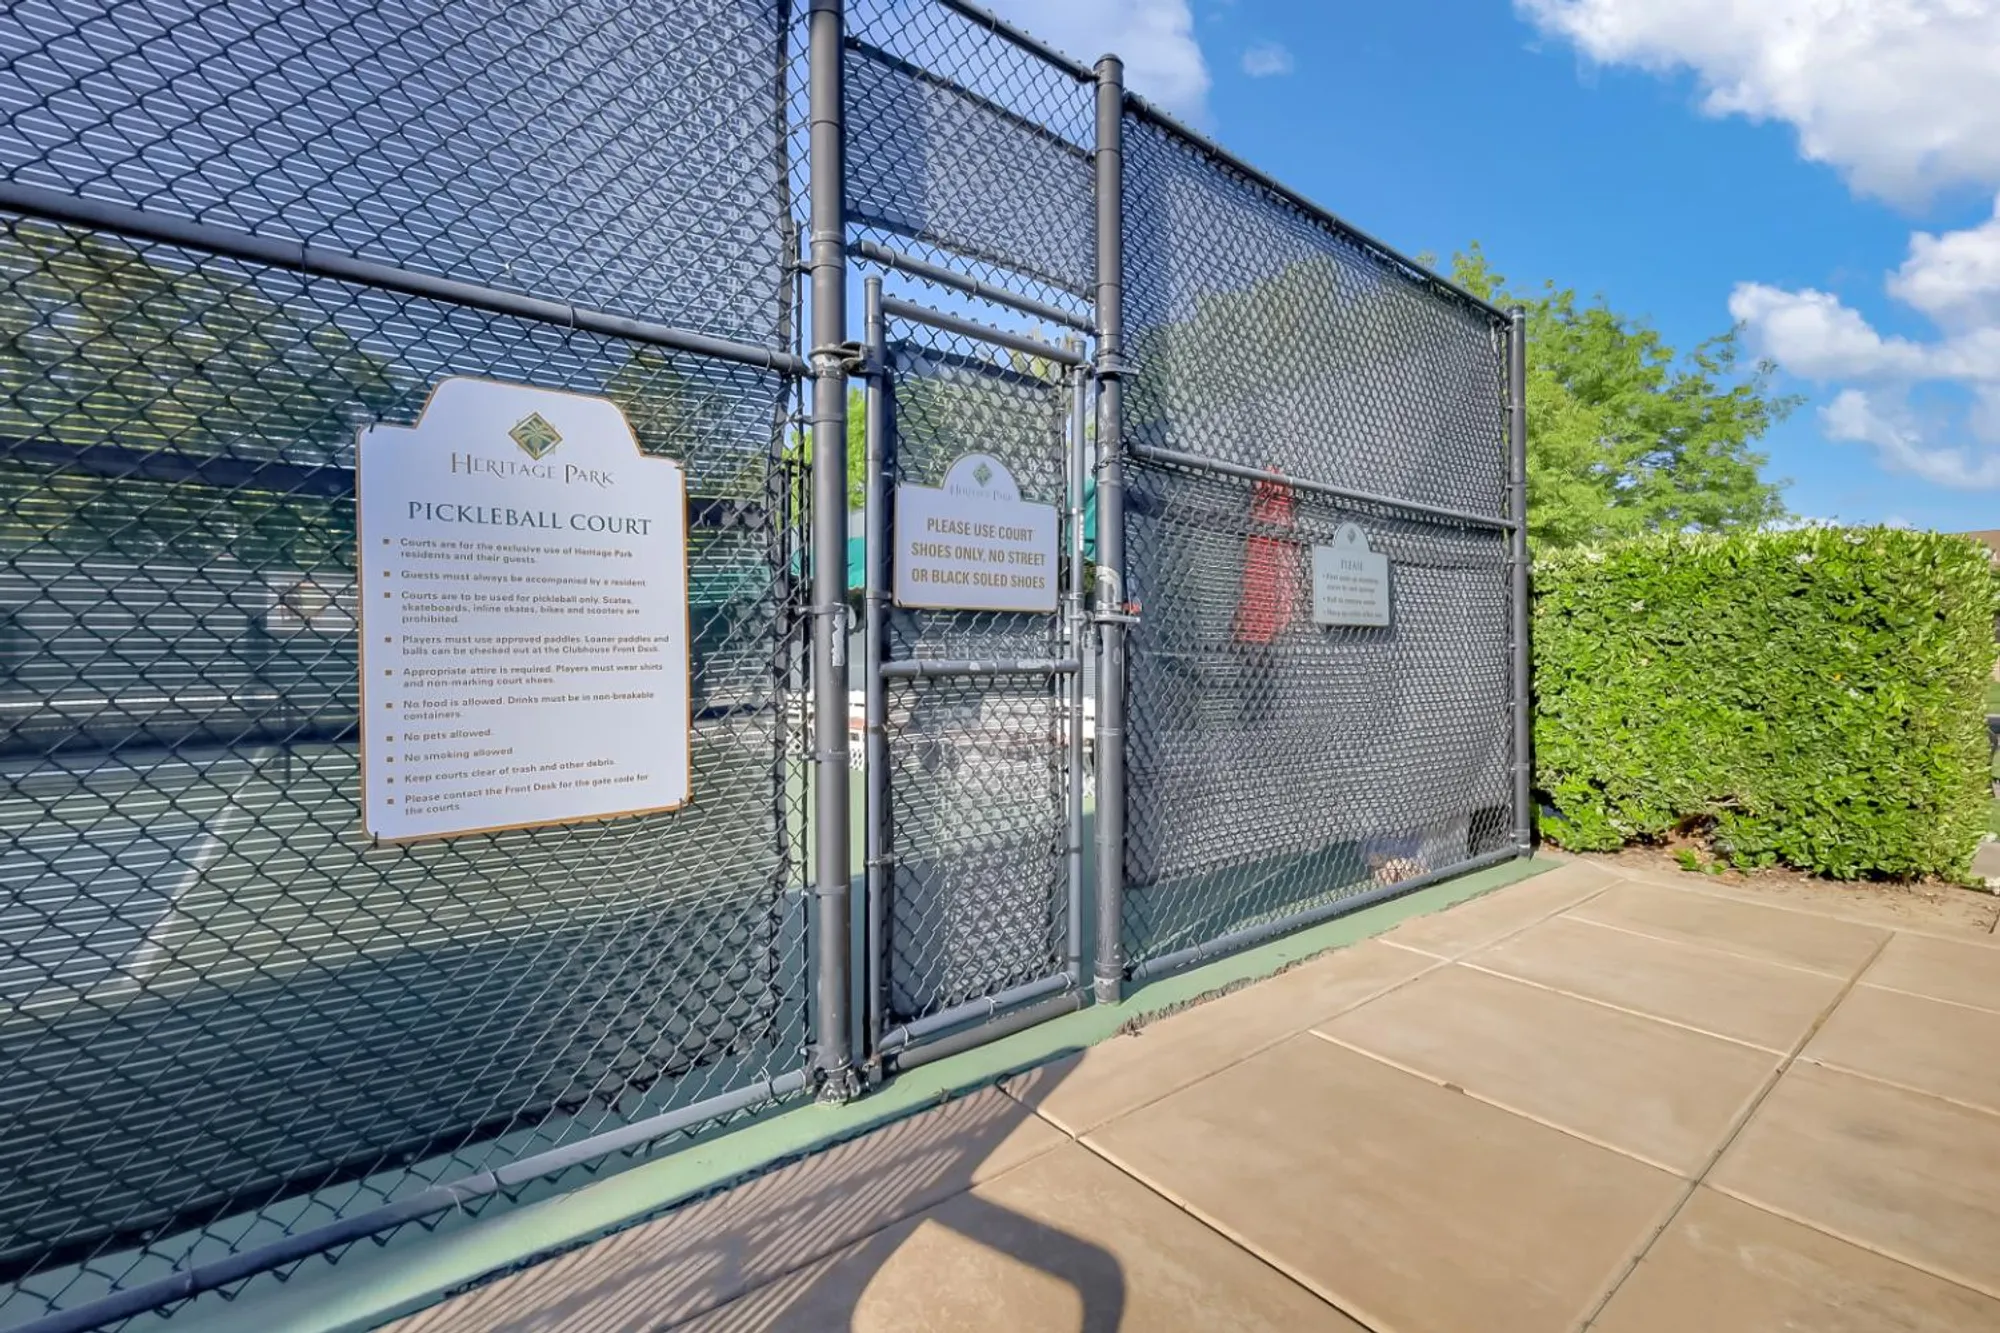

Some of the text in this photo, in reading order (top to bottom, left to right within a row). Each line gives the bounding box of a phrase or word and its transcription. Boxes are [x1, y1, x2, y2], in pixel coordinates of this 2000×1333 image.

[451, 452, 615, 488] HERITAGE PARK
[408, 501, 652, 535] PICKLEBALL COURT
[927, 518, 1033, 541] PLEASE USE COURT
[400, 538, 437, 548] Courts
[460, 541, 473, 549] for
[401, 550, 450, 559] residents
[476, 553, 500, 562] their
[911, 542, 951, 558] SHOES
[989, 551, 1004, 563] NO
[1008, 552, 1046, 566] STREET
[401, 570, 439, 579] Guests
[443, 572, 470, 580] must
[473, 573, 507, 582] always
[590, 577, 601, 586] by
[912, 568, 1045, 588] OR BLACK SOLED SHOES
[401, 591, 438, 600] Courts
[461, 593, 471, 601] to
[490, 593, 514, 601] used
[533, 594, 577, 604] pickleball
[474, 604, 500, 612] inline
[403, 635, 441, 644] Players
[496, 635, 541, 644] approved
[618, 636, 651, 644] paddles
[403, 647, 428, 655] balls
[432, 647, 450, 655] can
[403, 668, 466, 677] Appropriate
[471, 666, 496, 674] attire
[500, 666, 507, 674] is
[403, 700, 419, 708] No
[423, 700, 447, 708] food
[508, 696, 538, 704] Drinks
[404, 732, 420, 741] No
[423, 731, 446, 741] pets
[404, 753, 420, 761] No
[424, 750, 469, 760] smoking
[405, 774, 431, 783] Keep
[435, 771, 468, 780] courts
[472, 769, 495, 777] clear
[499, 767, 509, 775] of
[512, 765, 536, 773] trash
[540, 763, 557, 771] and
[560, 762, 584, 770] other
[405, 793, 439, 803] Please
[444, 789, 482, 799] contact
[485, 787, 501, 795] the
[505, 785, 530, 794] Front
[534, 782, 556, 790] Desk
[592, 778, 611, 787] gate
[405, 807, 422, 815] the
